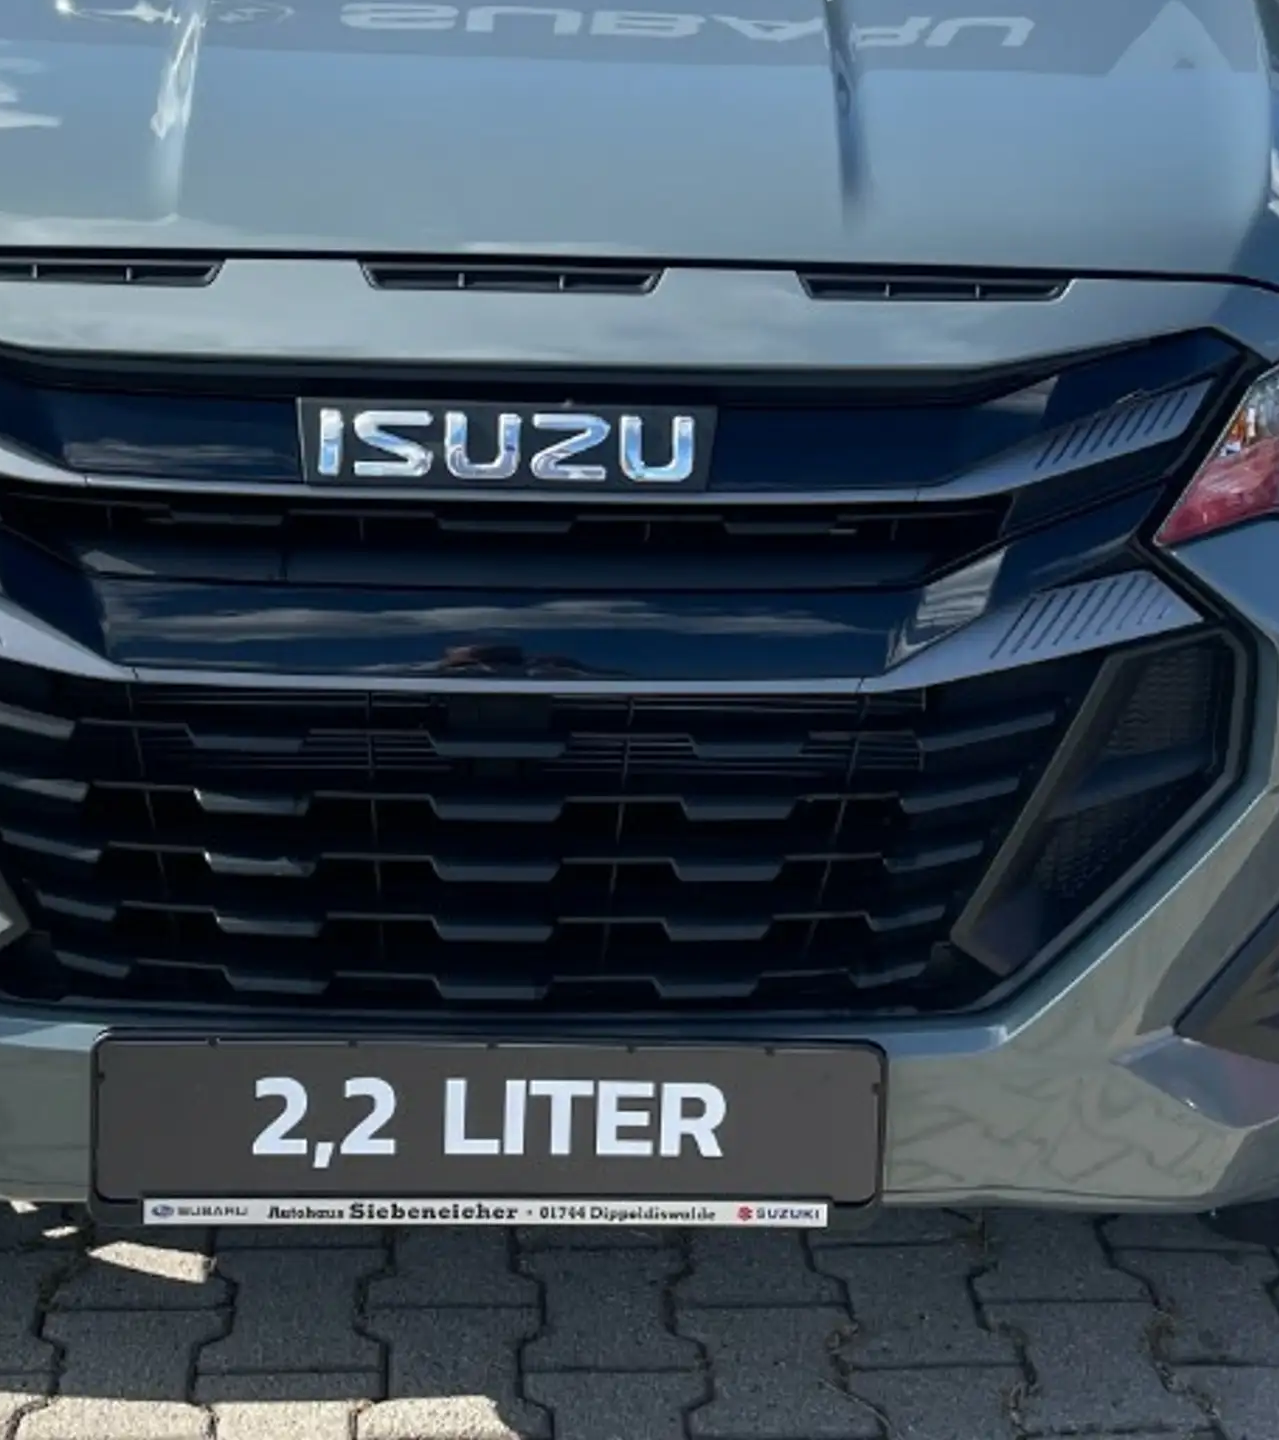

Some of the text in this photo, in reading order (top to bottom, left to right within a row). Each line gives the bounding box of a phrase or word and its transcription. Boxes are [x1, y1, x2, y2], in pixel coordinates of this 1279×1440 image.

[317, 408, 696, 482] ISUZU
[252, 1076, 727, 1168] 2,2 LITER
[267, 1205, 345, 1220] Autohaus
[348, 1202, 519, 1221] Siebeneicher
[756, 1208, 821, 1221] SUZUKI
